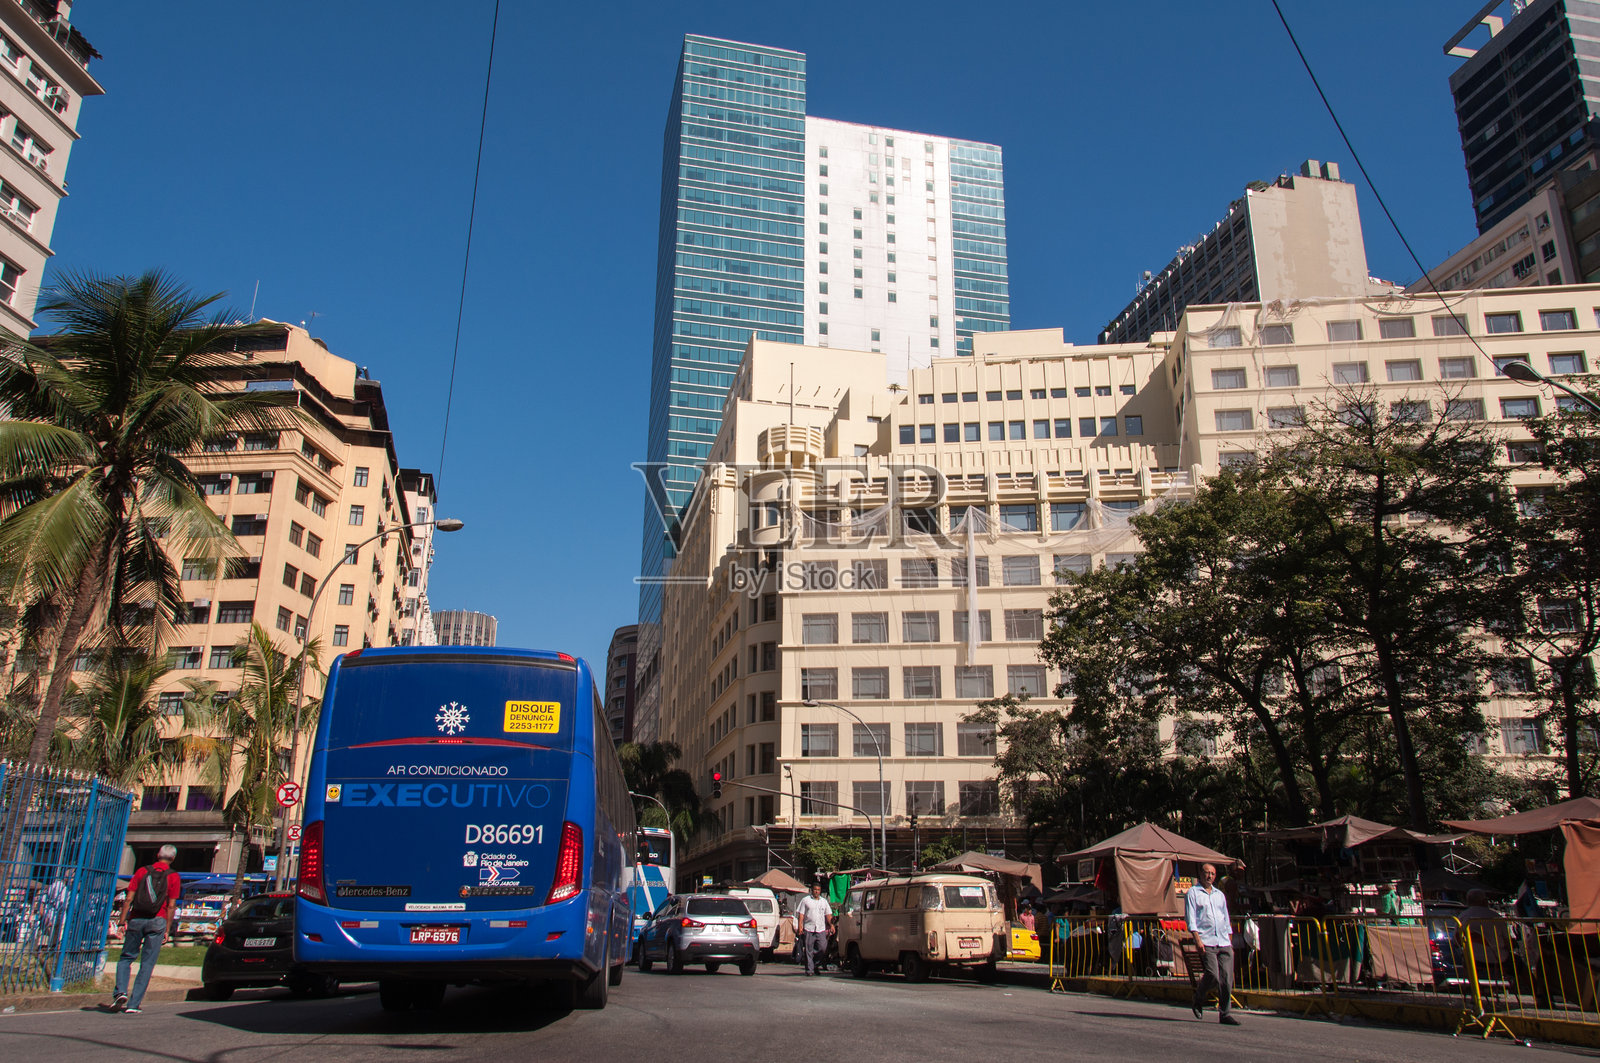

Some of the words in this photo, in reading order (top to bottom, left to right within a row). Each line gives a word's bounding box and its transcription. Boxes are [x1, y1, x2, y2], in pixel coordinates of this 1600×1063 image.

[510, 703, 555, 714] DISQUE
[509, 713, 554, 722] DENÚNCIA
[509, 722, 554, 730] 2253-1177
[387, 765, 406, 775] AR
[408, 765, 509, 776] CONDICIONADO
[342, 783, 551, 809] EXECUTIVO
[465, 824, 544, 844] D86691
[343, 886, 409, 896] Mercedes-Benz
[412, 931, 458, 942] LRP-6976
